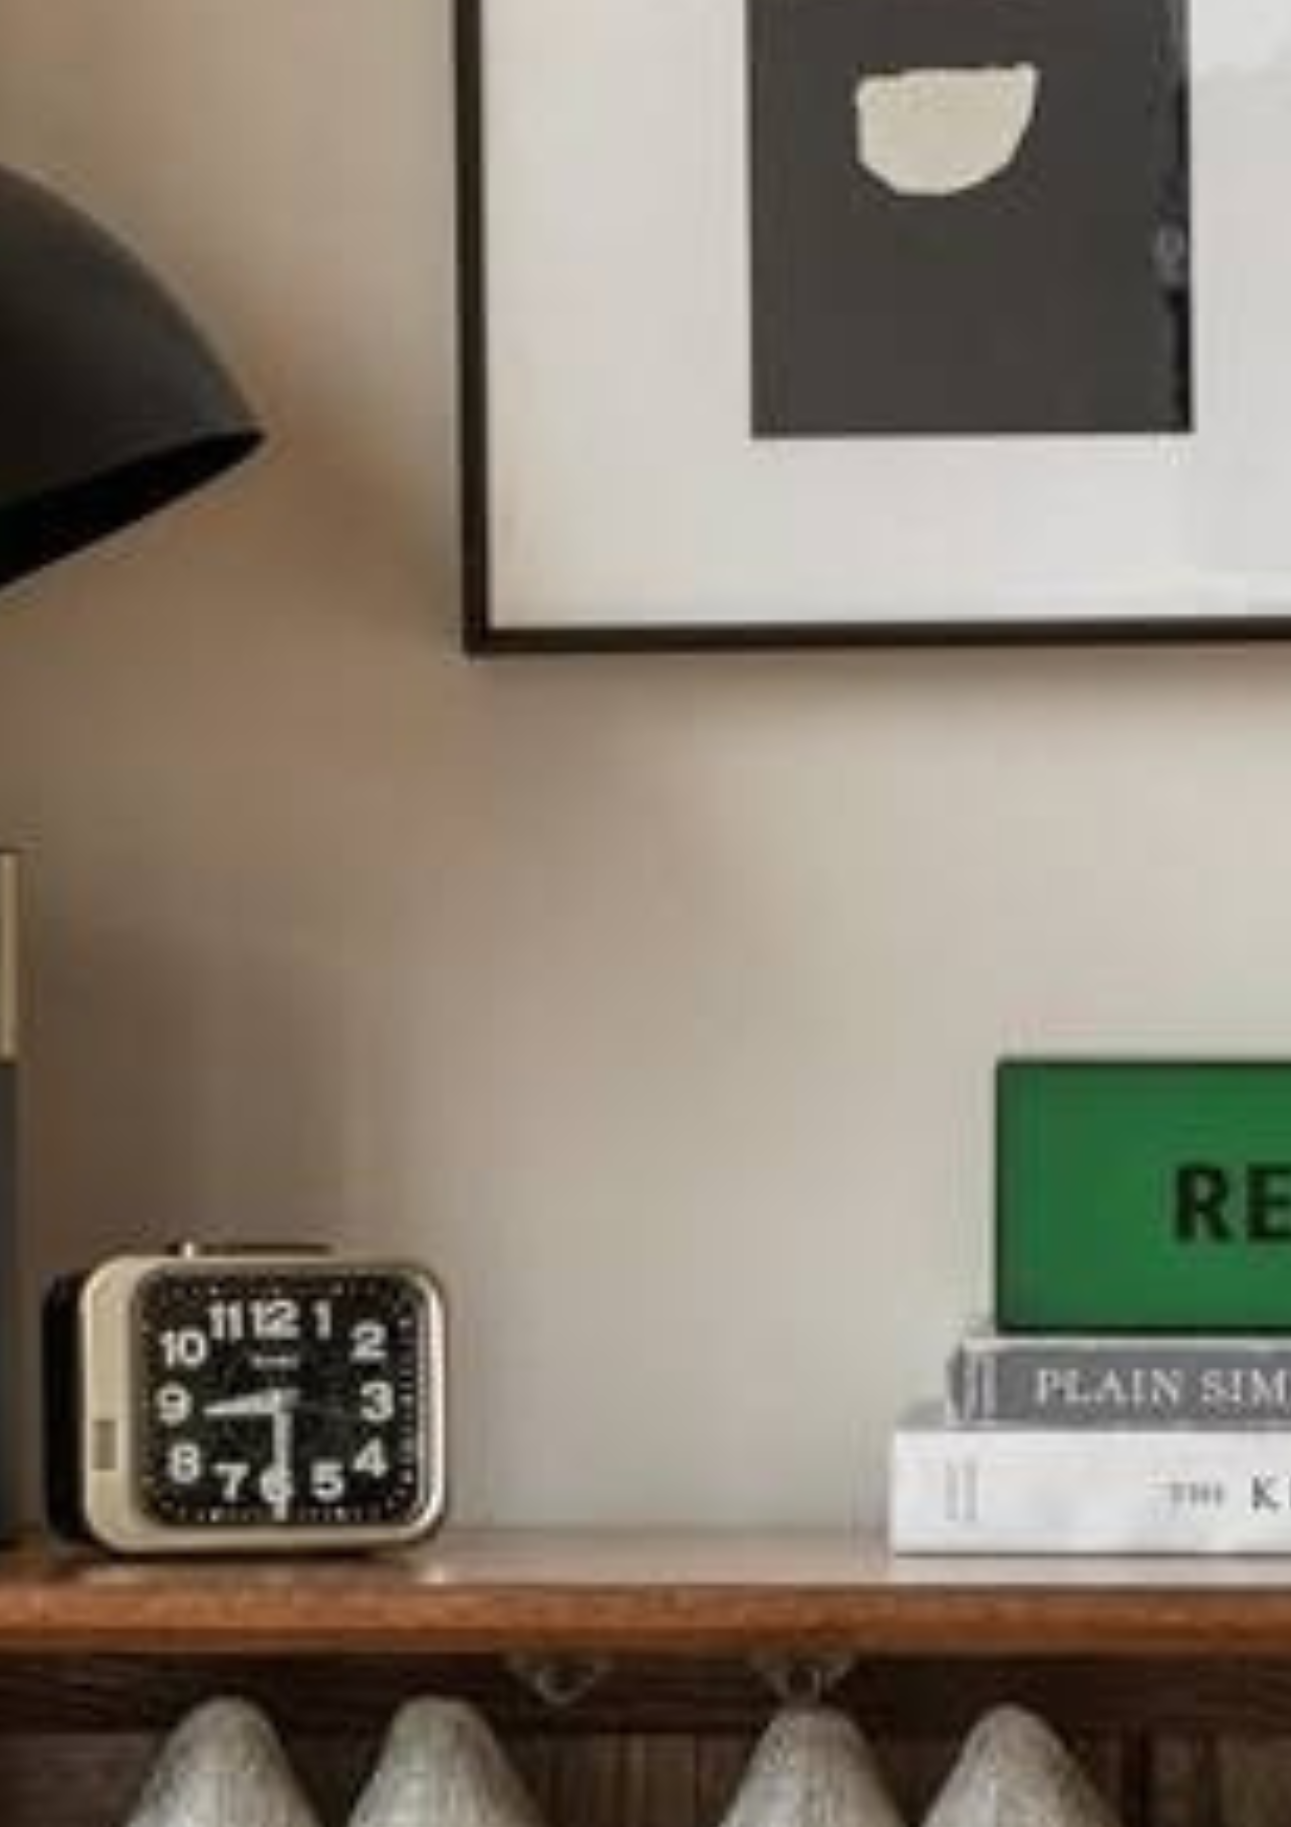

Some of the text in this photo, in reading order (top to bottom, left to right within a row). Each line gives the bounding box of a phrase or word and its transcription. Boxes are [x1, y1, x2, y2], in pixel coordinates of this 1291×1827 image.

[209, 1299, 332, 1341] 11 12 1
[159, 1328, 208, 1368] 10
[349, 1321, 388, 1362] 2
[155, 1383, 193, 1427] 9
[359, 1380, 394, 1422] 3
[1035, 1367, 1182, 1407] PLAIN
[168, 1442, 201, 1485] 8
[352, 1437, 388, 1479] 4
[212, 1461, 250, 1501] 7
[312, 1461, 345, 1502] 5
